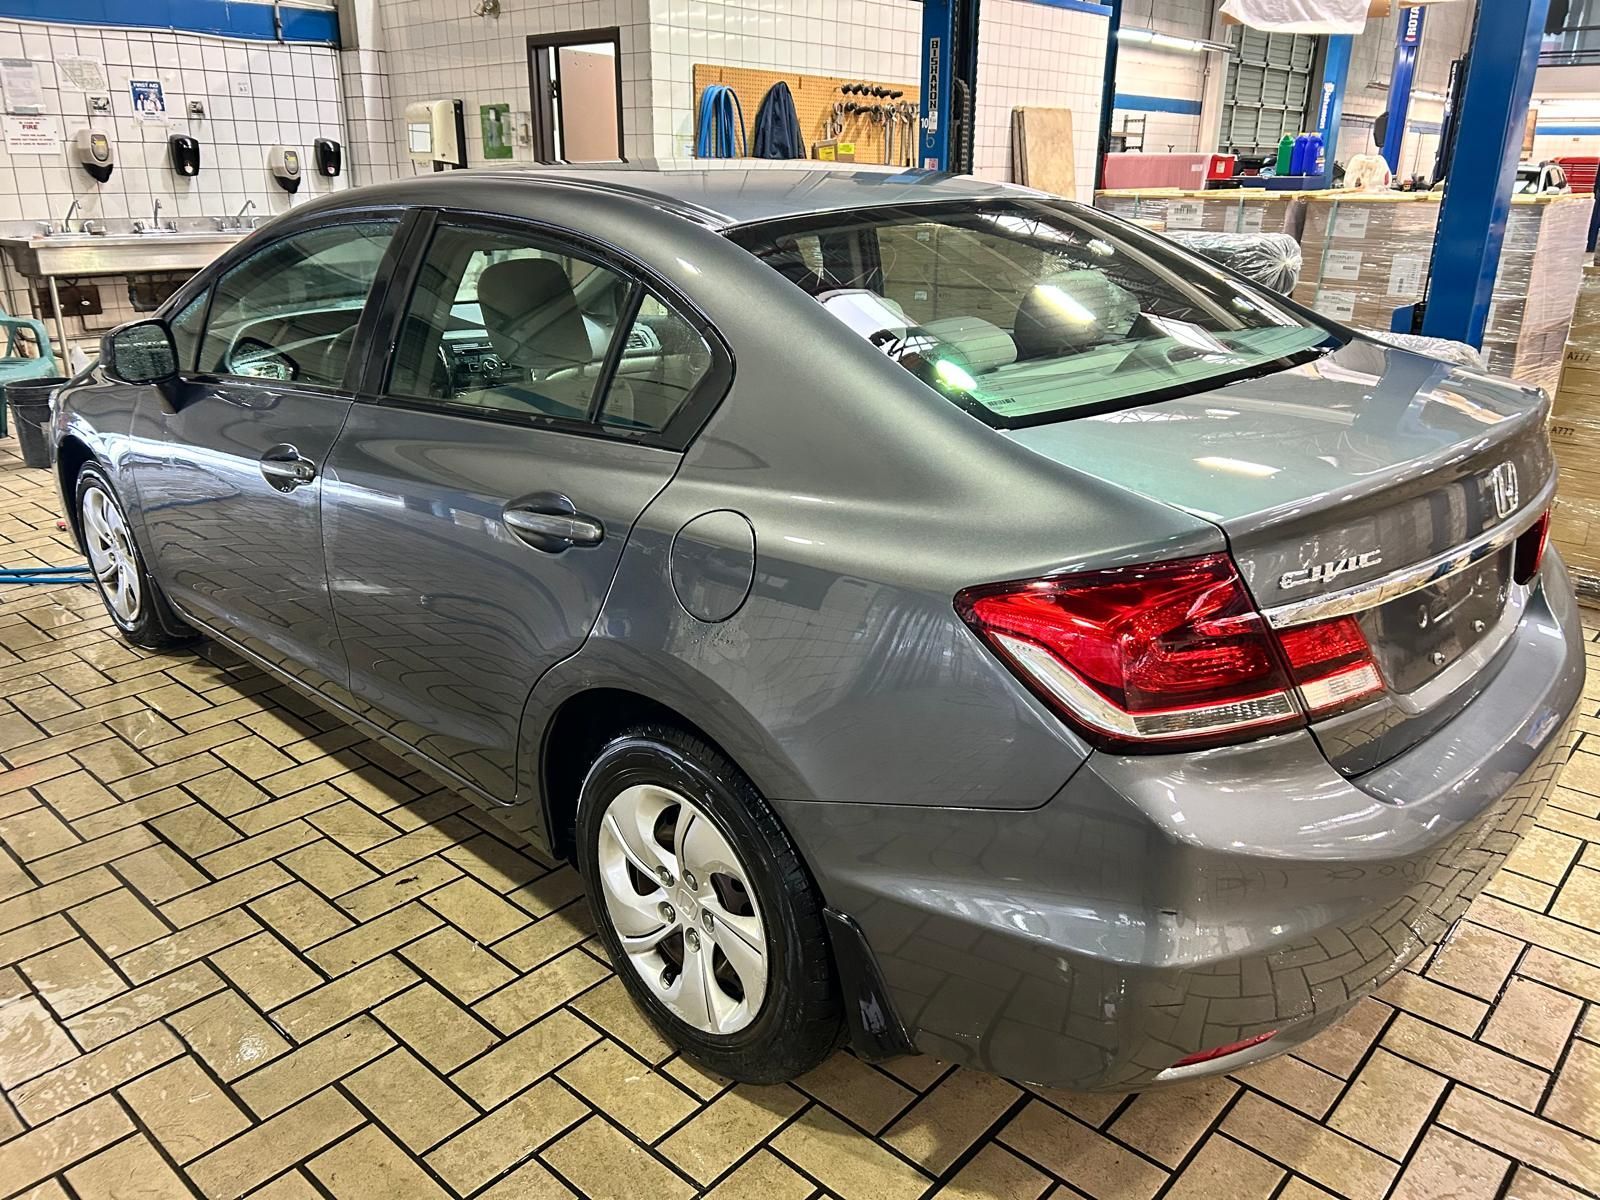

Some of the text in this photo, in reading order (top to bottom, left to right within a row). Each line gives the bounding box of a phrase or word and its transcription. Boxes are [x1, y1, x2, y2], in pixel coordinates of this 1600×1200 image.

[1407, 6, 1420, 35] ROTA
[929, 40, 939, 109] BISHAMON
[920, 118, 929, 129] 10
[1567, 351, 1591, 361] A777
[1551, 426, 1575, 436] A777
[1279, 549, 1383, 589] CIVIC
